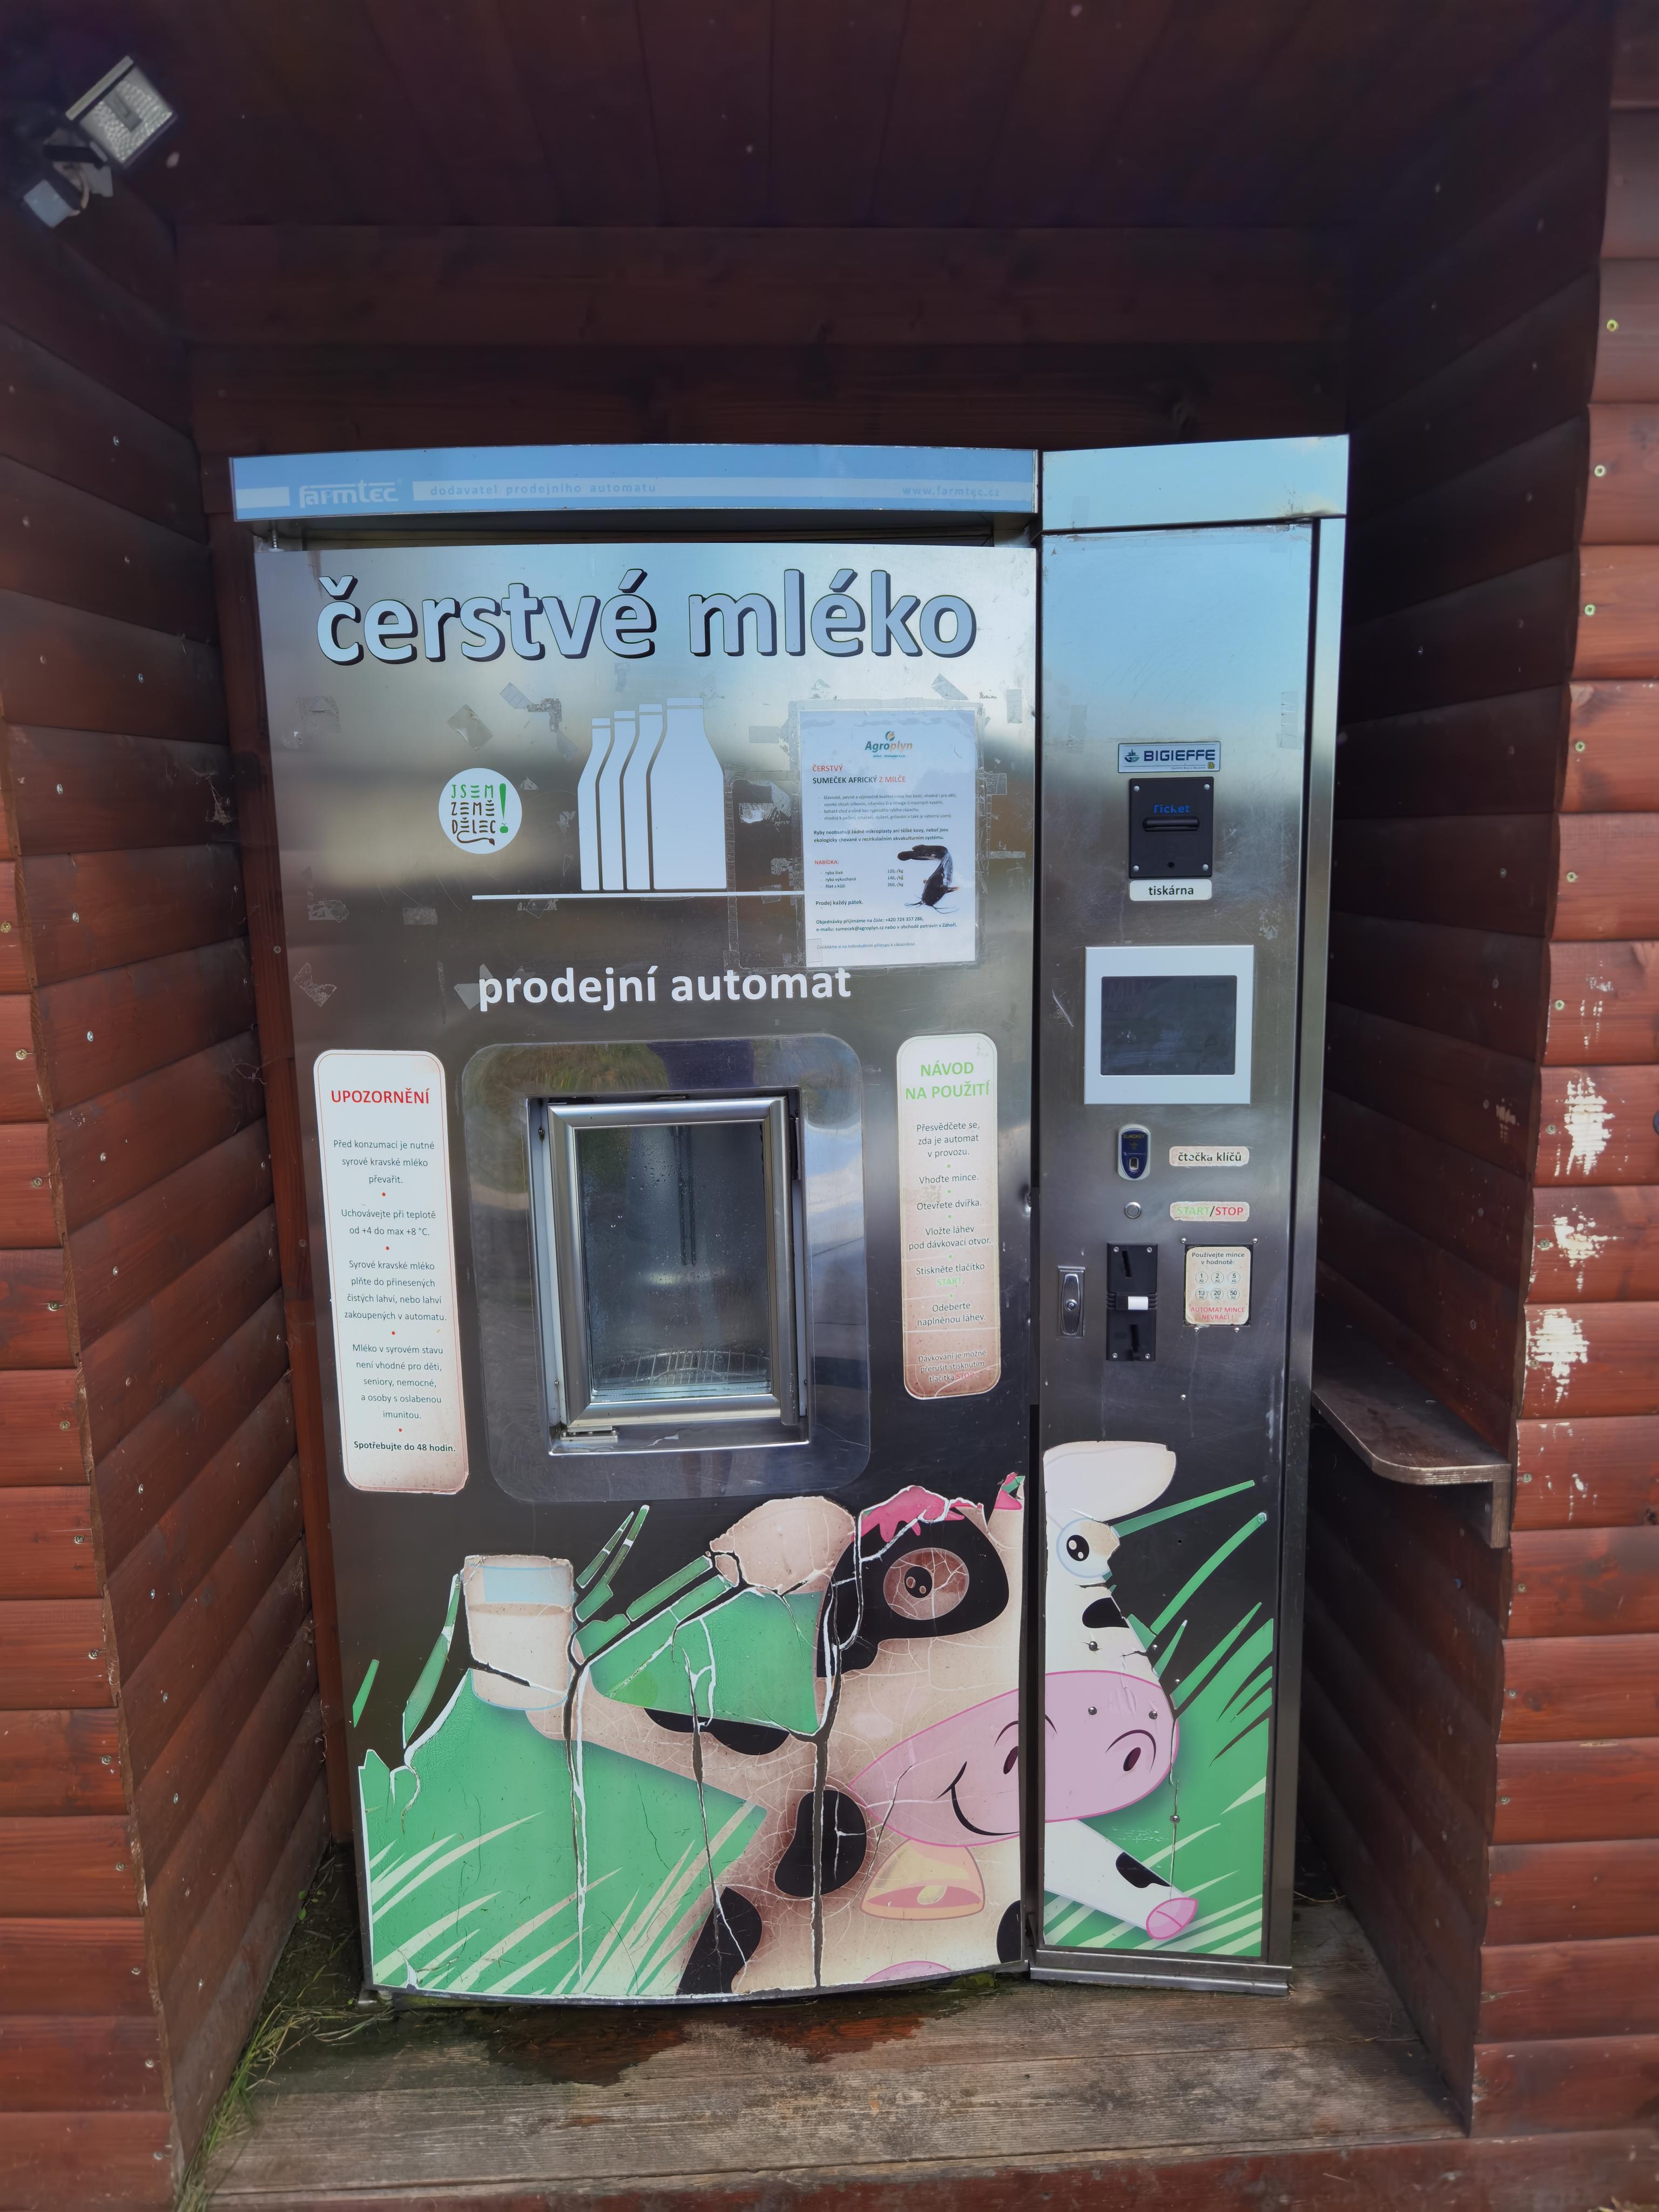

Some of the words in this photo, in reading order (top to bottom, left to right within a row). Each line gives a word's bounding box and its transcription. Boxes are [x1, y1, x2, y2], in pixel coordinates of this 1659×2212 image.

[430, 484, 497, 496] dodavatel
[506, 483, 581, 496] prodejního
[589, 483, 656, 493] automatu
[902, 485, 1001, 496] www.farmtec.cz
[316, 569, 656, 666] čerstvé
[689, 569, 977, 658] mléko
[864, 740, 913, 753] Agroplyn
[1144, 749, 1215, 761] BIGIEFFE
[812, 775, 847, 784] SUMEČEK
[848, 775, 877, 783] AFRICKÝ
[885, 774, 906, 783] MILČE
[451, 784, 494, 798] JSEM
[451, 800, 495, 816] ZEMĚ
[1154, 804, 1190, 813] Ticket
[451, 817, 496, 834] DĚLEC
[1148, 885, 1194, 895] tiskárna
[479, 965, 658, 1011] prodejní
[671, 967, 851, 1001] automat
[920, 1060, 974, 1076] NÁVOD
[905, 1087, 927, 1100] NA
[932, 1080, 989, 1098] POUŽITÍ
[331, 1088, 430, 1104] UPOZORNĚNÍ
[916, 1122, 966, 1132] Přesvědčete
[334, 1139, 352, 1148] Před
[354, 1139, 397, 1149] konzumací
[400, 1141, 407, 1150] je
[410, 1141, 434, 1149] nutné
[918, 1136, 932, 1145] zda
[934, 1136, 942, 1146] je
[944, 1134, 979, 1143] automat
[935, 1149, 970, 1158] provozu.
[1216, 1151, 1242, 1162] klíčů
[342, 1157, 368, 1166] syrové
[370, 1157, 400, 1166] kravské
[403, 1158, 428, 1166] mléko
[369, 1175, 403, 1184] převařit.
[919, 1175, 949, 1184] Vhoďte
[952, 1174, 979, 1182] mince.
[916, 1201, 953, 1210] Otevřete
[955, 1199, 982, 1208] dvířka.
[341, 1209, 390, 1219] Uchovávejte
[393, 1210, 404, 1219] při
[406, 1210, 436, 1220] teplotě
[1176, 1205, 1244, 1217] START/STOP
[349, 1226, 359, 1234] od
[374, 1226, 385, 1235] do
[406, 1228, 416, 1236] +8
[419, 1227, 430, 1236] °C.
[925, 1226, 950, 1236] Vložte
[953, 1225, 974, 1233] láhev
[909, 1240, 924, 1251] pod
[927, 1238, 966, 1249] dávkovací
[349, 1260, 375, 1270] Syrové
[377, 1260, 407, 1269] kravské
[410, 1262, 435, 1270] mléko
[916, 1265, 953, 1275] Stiskněte
[955, 1262, 984, 1272] tlačítko
[351, 1277, 372, 1286] plňte
[374, 1277, 384, 1285] do
[386, 1278, 435, 1288] přinesených
[347, 1293, 374, 1304] čistých
[376, 1294, 397, 1304] lahví,
[400, 1295, 420, 1304] nebo
[422, 1296, 441, 1304] lahví
[932, 1303, 970, 1312] Odeberte
[345, 1310, 395, 1321] zakoupených
[917, 1316, 960, 1327] naplněnou
[963, 1313, 986, 1321] láhev.
[352, 1344, 377, 1352] Mléko
[386, 1345, 419, 1354] syrovém
[918, 1352, 953, 1362] Dávkování
[955, 1352, 961, 1360] je
[963, 1349, 986, 1358] možné
[375, 1361, 405, 1370] vhodné
[423, 1362, 442, 1372] děti,
[920, 1366, 947, 1374] přerušit
[949, 1361, 984, 1370] stisknutím
[363, 1378, 395, 1387] seniory,
[396, 1379, 437, 1388] nemocné,
[929, 1373, 954, 1384] tlačítka
[368, 1393, 392, 1404] osoby
[400, 1394, 441, 1403] oslabenou
[383, 1410, 422, 1419] imunitou.
[354, 1441, 402, 1451] Spotřebujte
[404, 1442, 415, 1451] do
[429, 1444, 456, 1452] hodin.
